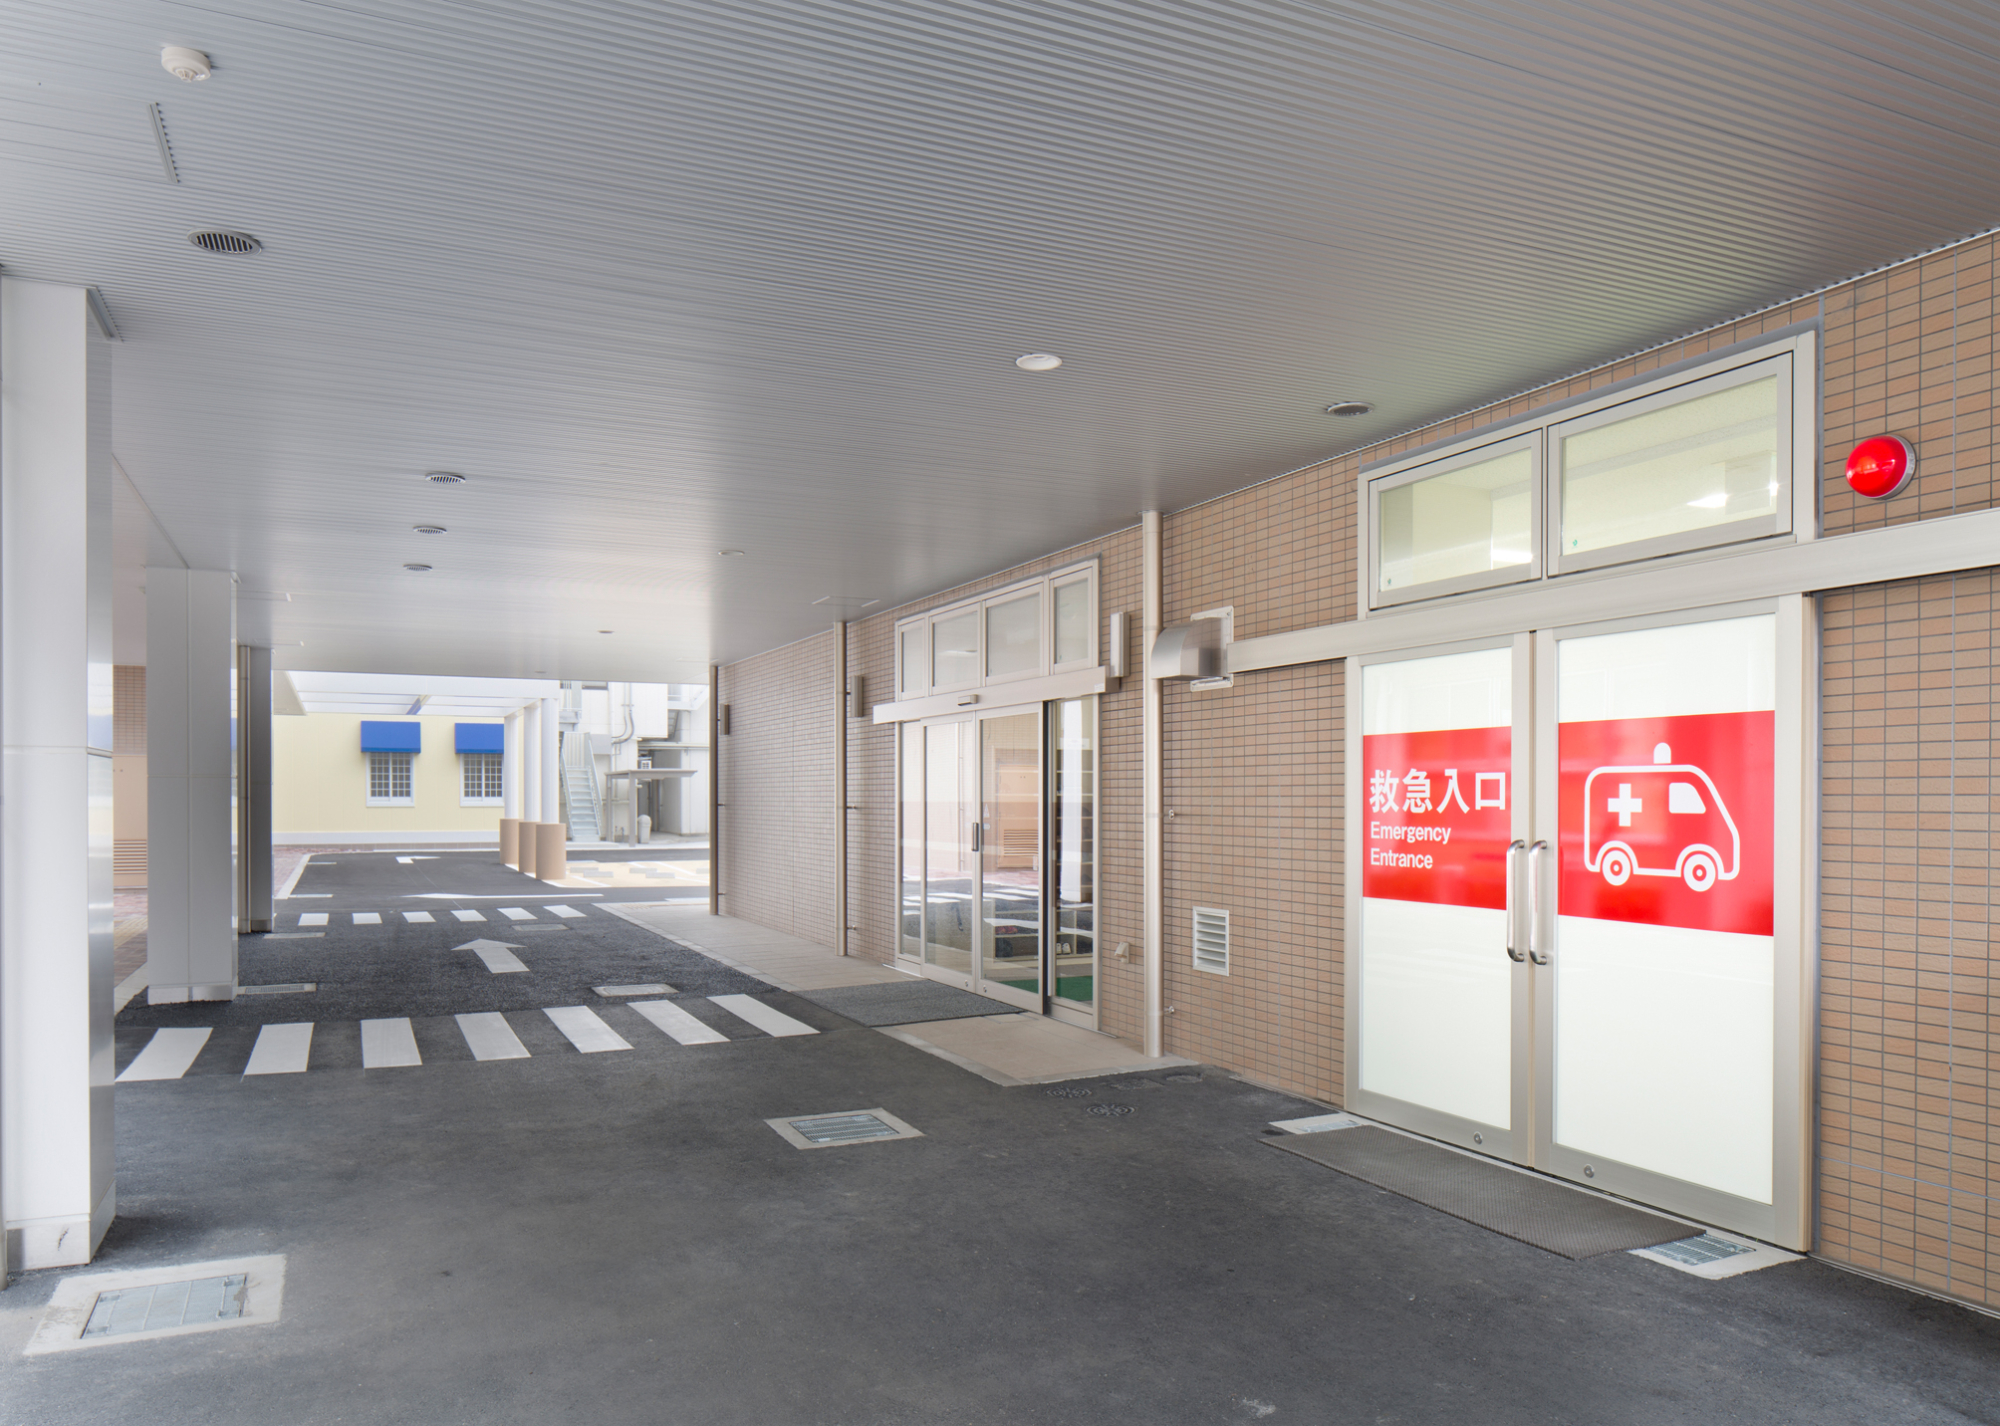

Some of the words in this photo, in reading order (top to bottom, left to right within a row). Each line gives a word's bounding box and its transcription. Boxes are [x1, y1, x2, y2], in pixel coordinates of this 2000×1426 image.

[1369, 768, 1506, 814] 救急入口
[1370, 821, 1452, 845] Emergency
[1370, 847, 1433, 869] Entrance
